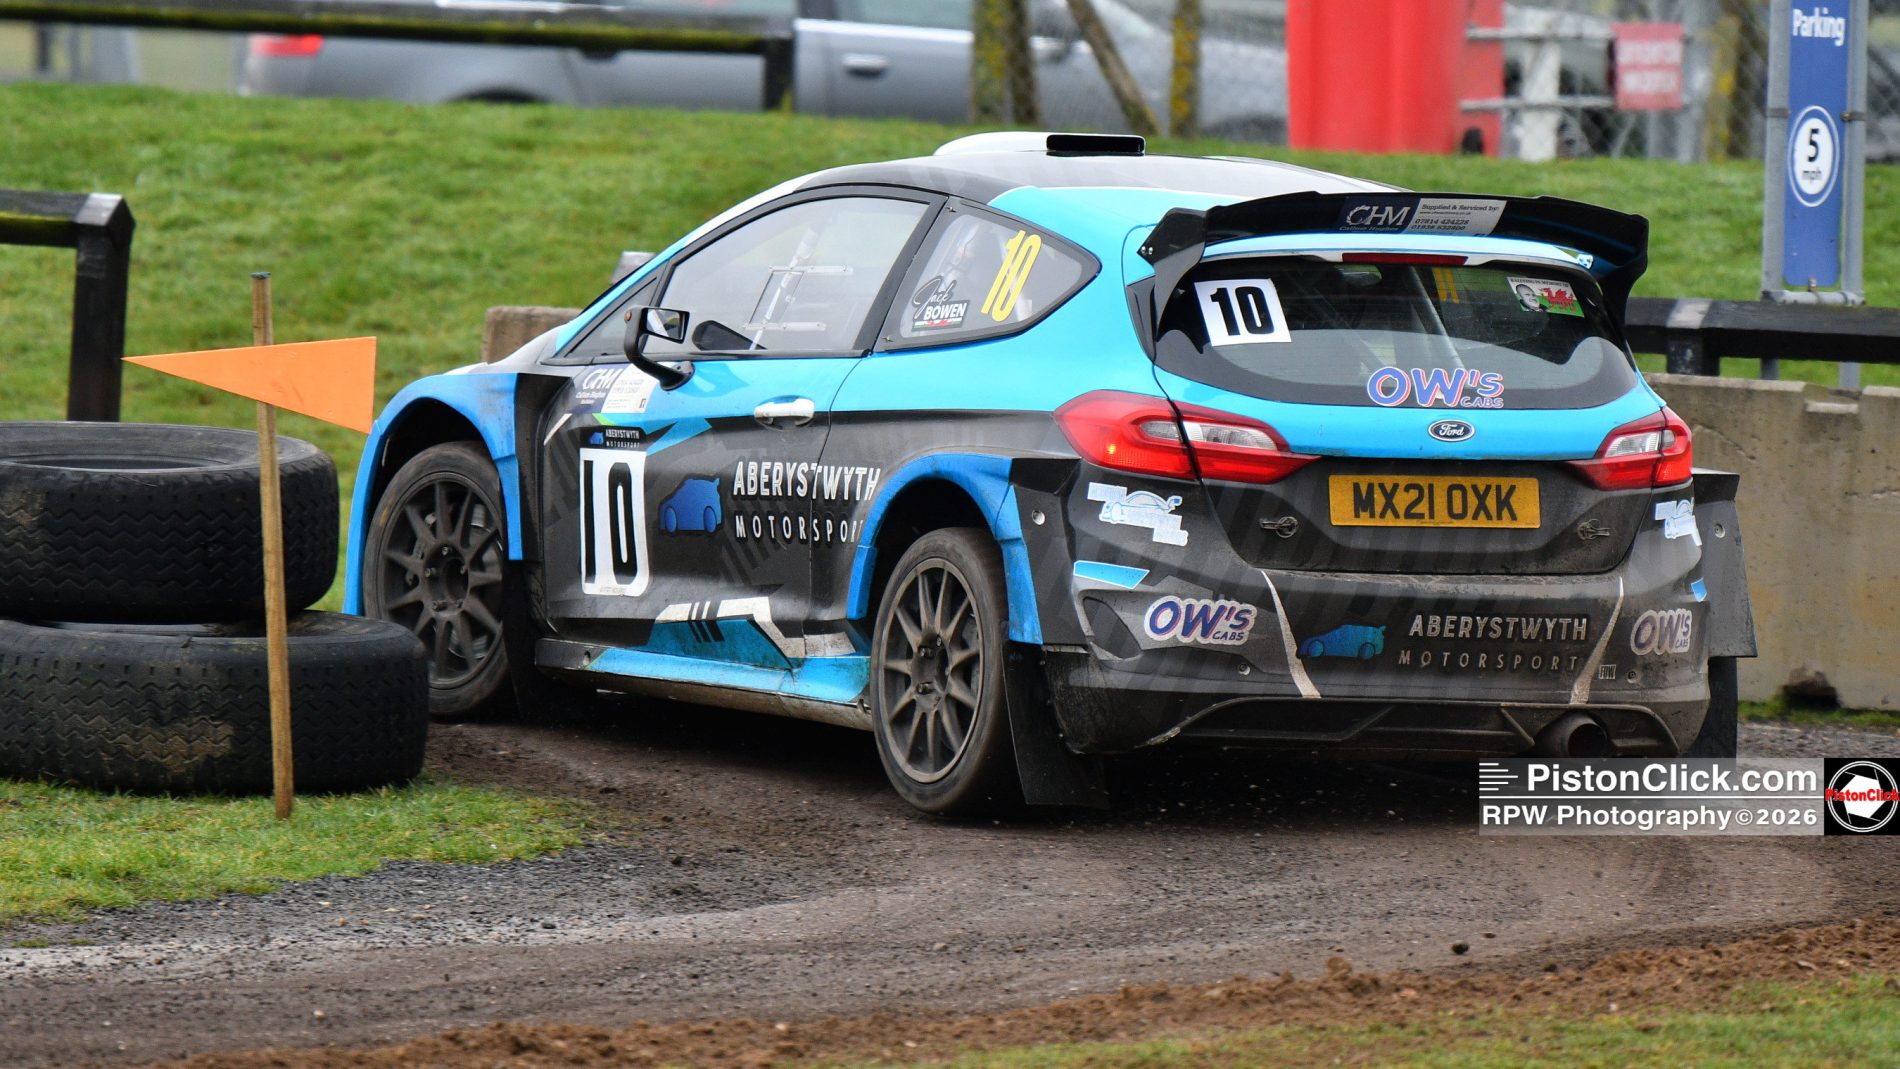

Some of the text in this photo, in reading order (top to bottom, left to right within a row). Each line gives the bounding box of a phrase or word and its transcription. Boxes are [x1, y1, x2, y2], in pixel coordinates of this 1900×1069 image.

[1792, 7, 1846, 47] Parking
[1807, 128, 1820, 162] 5
[1802, 168, 1822, 183] mph
[1345, 204, 1411, 226] CHM
[980, 230, 1042, 322] 10
[913, 275, 957, 319] Jack
[923, 302, 967, 321] BOWEN
[1209, 286, 1275, 336] 10
[582, 368, 623, 390] CHM
[1460, 396, 1505, 409] CABS
[1439, 423, 1464, 437] Ford
[733, 461, 881, 500] ABERYSTWYTH
[1352, 482, 1518, 521] MX21 OXK
[583, 459, 638, 585] 10
[1212, 631, 1245, 641] CABS
[1408, 614, 1588, 641] ABERYSTWYTH
[1398, 650, 1577, 671] MOTORSPORT
